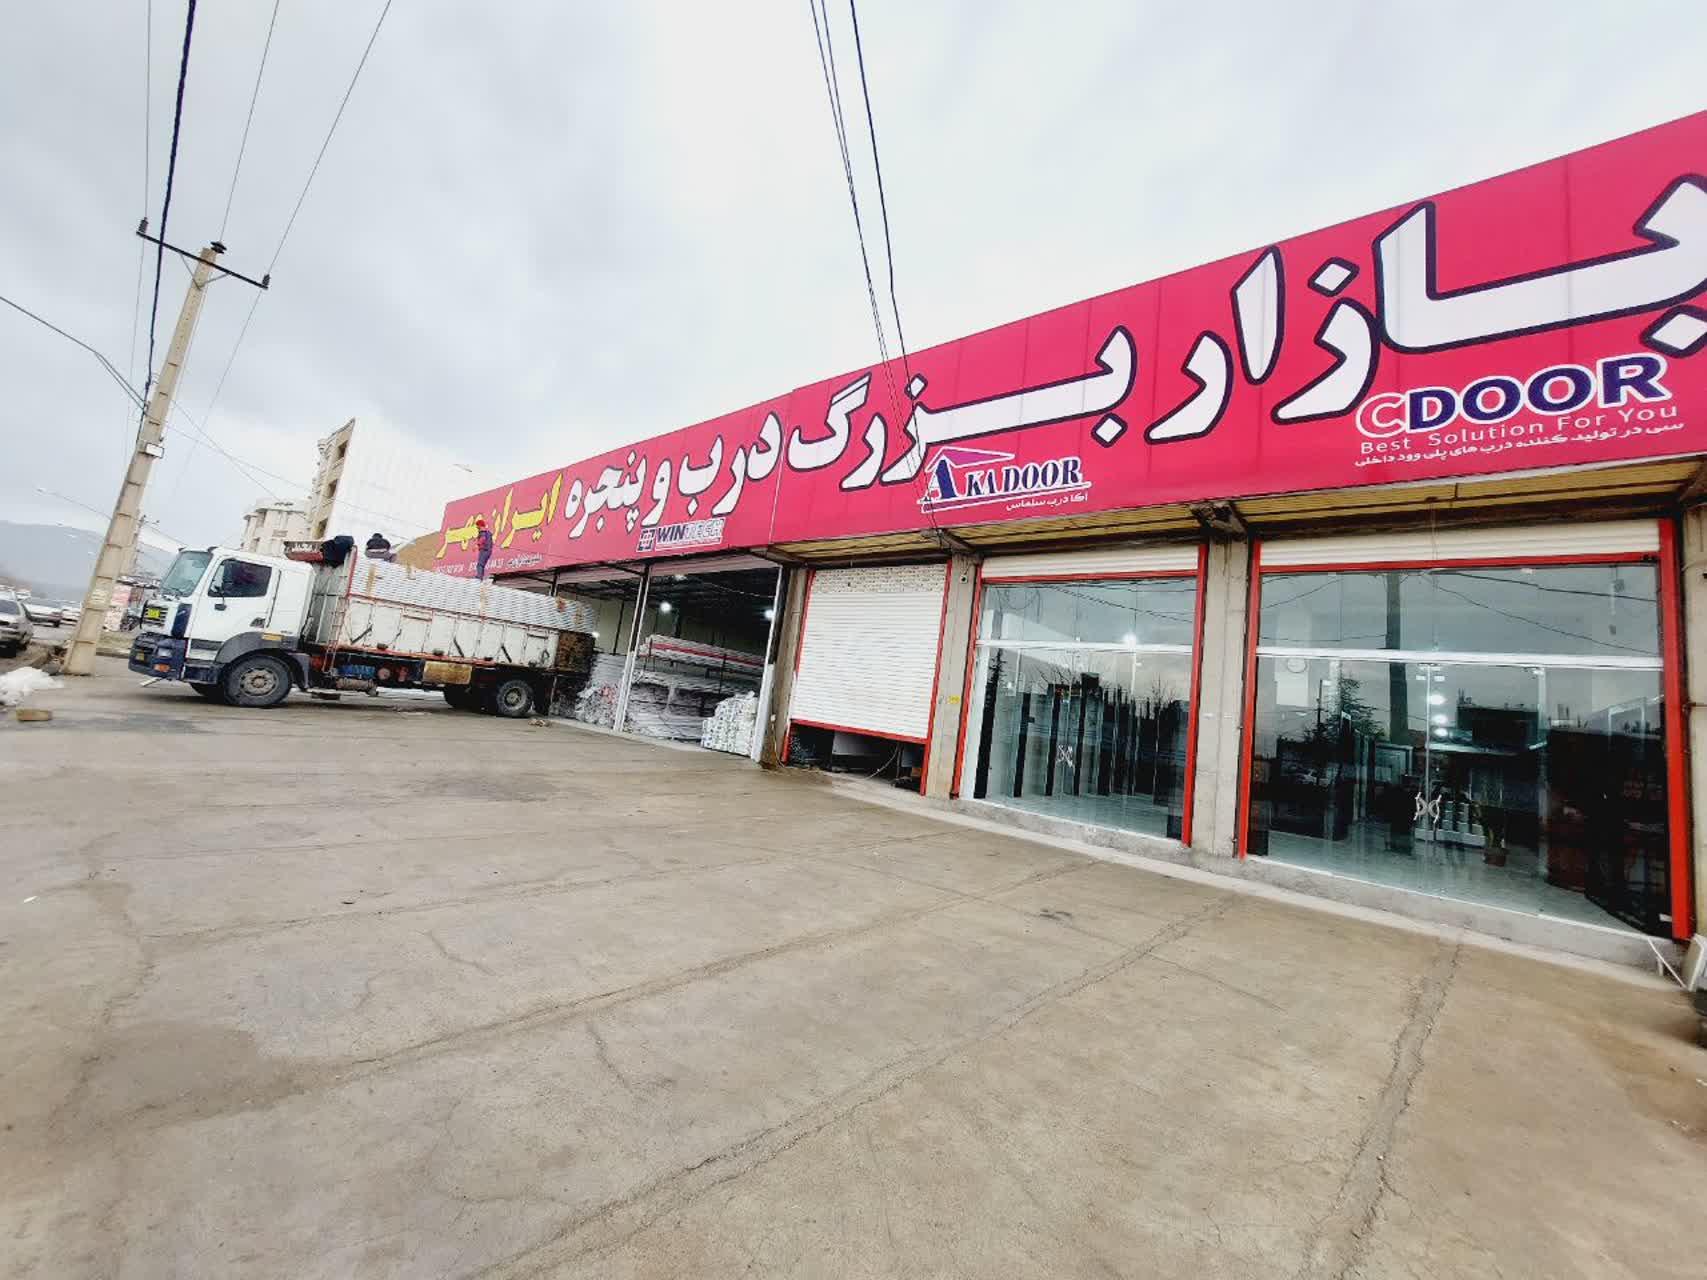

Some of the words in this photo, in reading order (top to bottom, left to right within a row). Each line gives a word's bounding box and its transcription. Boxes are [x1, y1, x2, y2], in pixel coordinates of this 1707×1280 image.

[1146, 173, 1707, 444] بازار
[787, 325, 1137, 491] بزرگ
[1355, 353, 1672, 438] CDOOR
[1361, 438, 1411, 453] Best
[1428, 423, 1543, 446] Solution
[1557, 414, 1606, 430] For
[1618, 405, 1677, 422] You
[677, 411, 783, 519] درب
[1450, 445, 1477, 456] های
[1479, 440, 1512, 454] درب
[1516, 434, 1568, 448] کننده
[1572, 427, 1617, 442] تولید
[564, 450, 648, 540] پنجره
[641, 458, 672, 527] و
